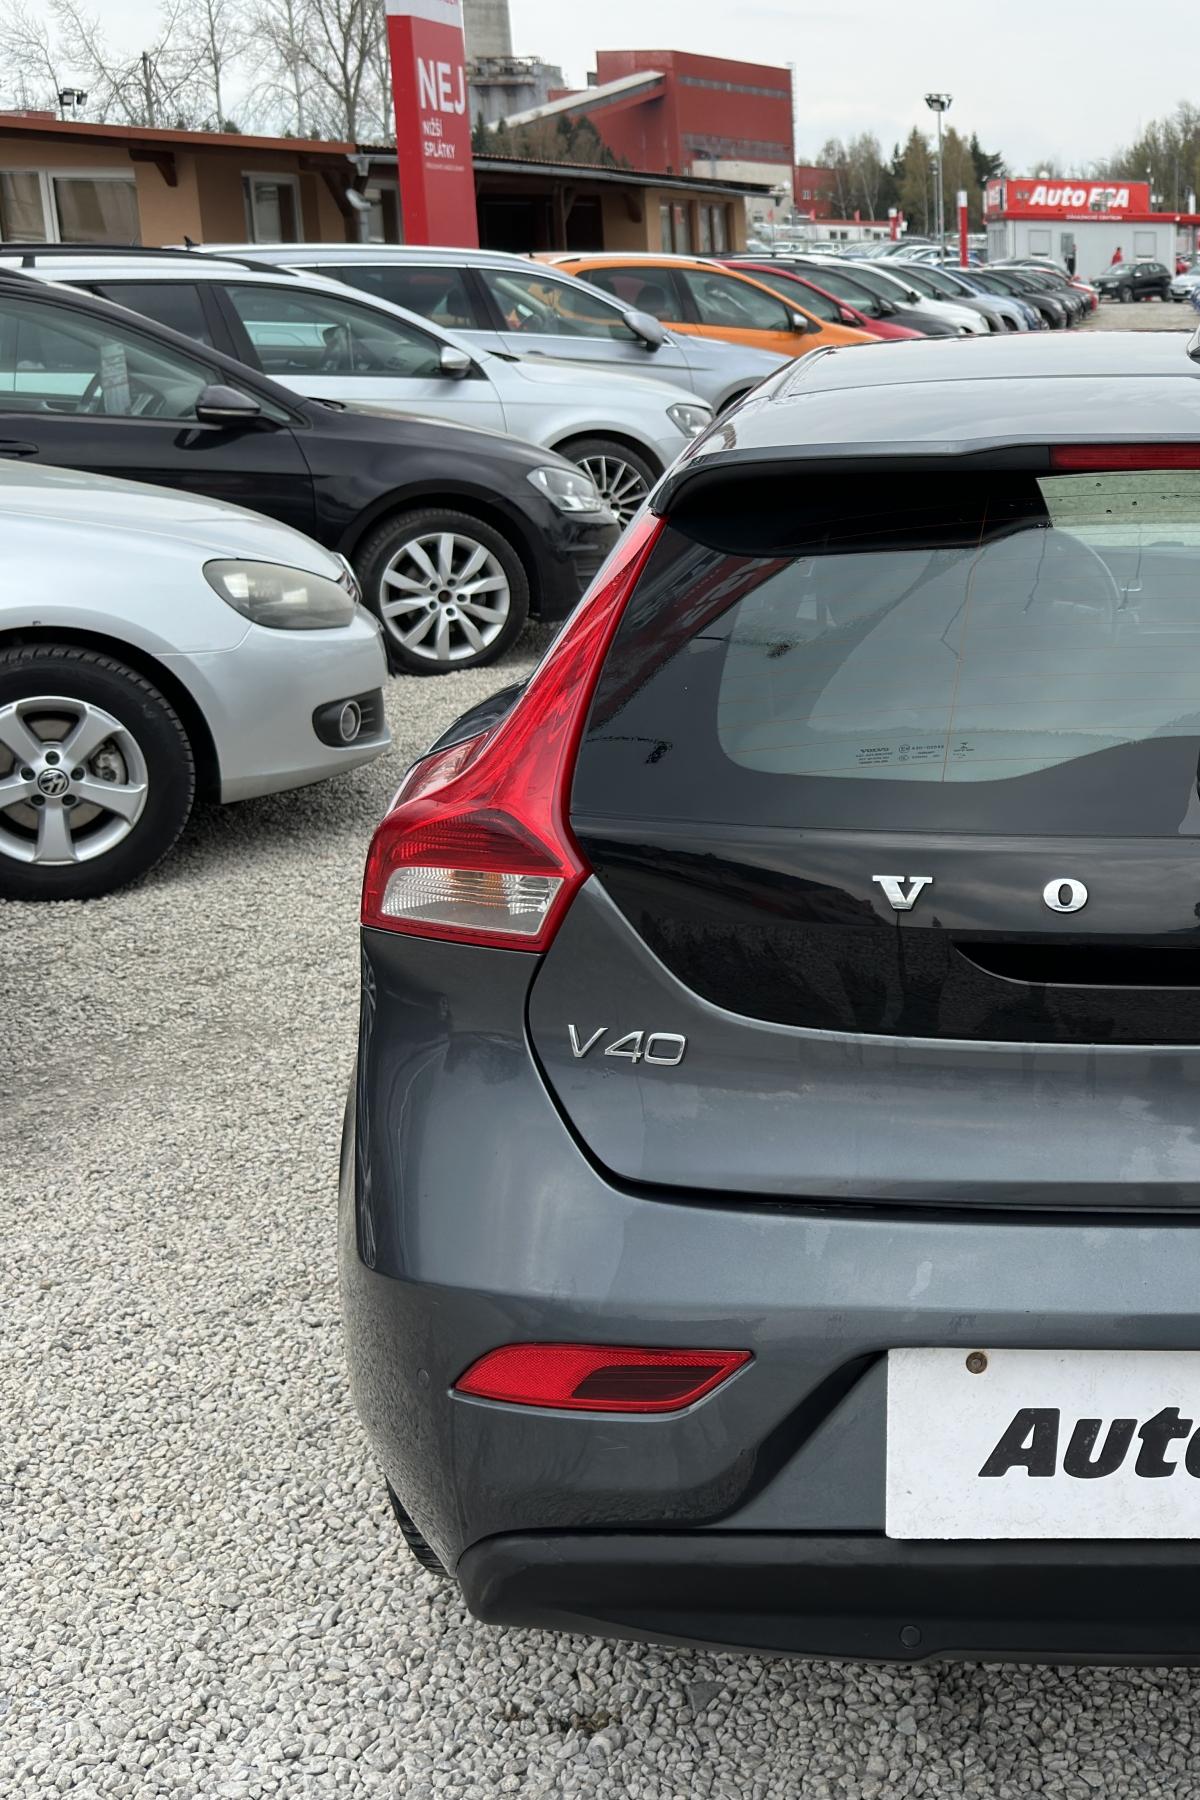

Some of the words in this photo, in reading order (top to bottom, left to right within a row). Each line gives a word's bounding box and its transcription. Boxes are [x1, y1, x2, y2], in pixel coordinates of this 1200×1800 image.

[417, 57, 466, 115] NEJ
[1029, 185, 1087, 207] Auto
[567, 1024, 687, 1066] V40
